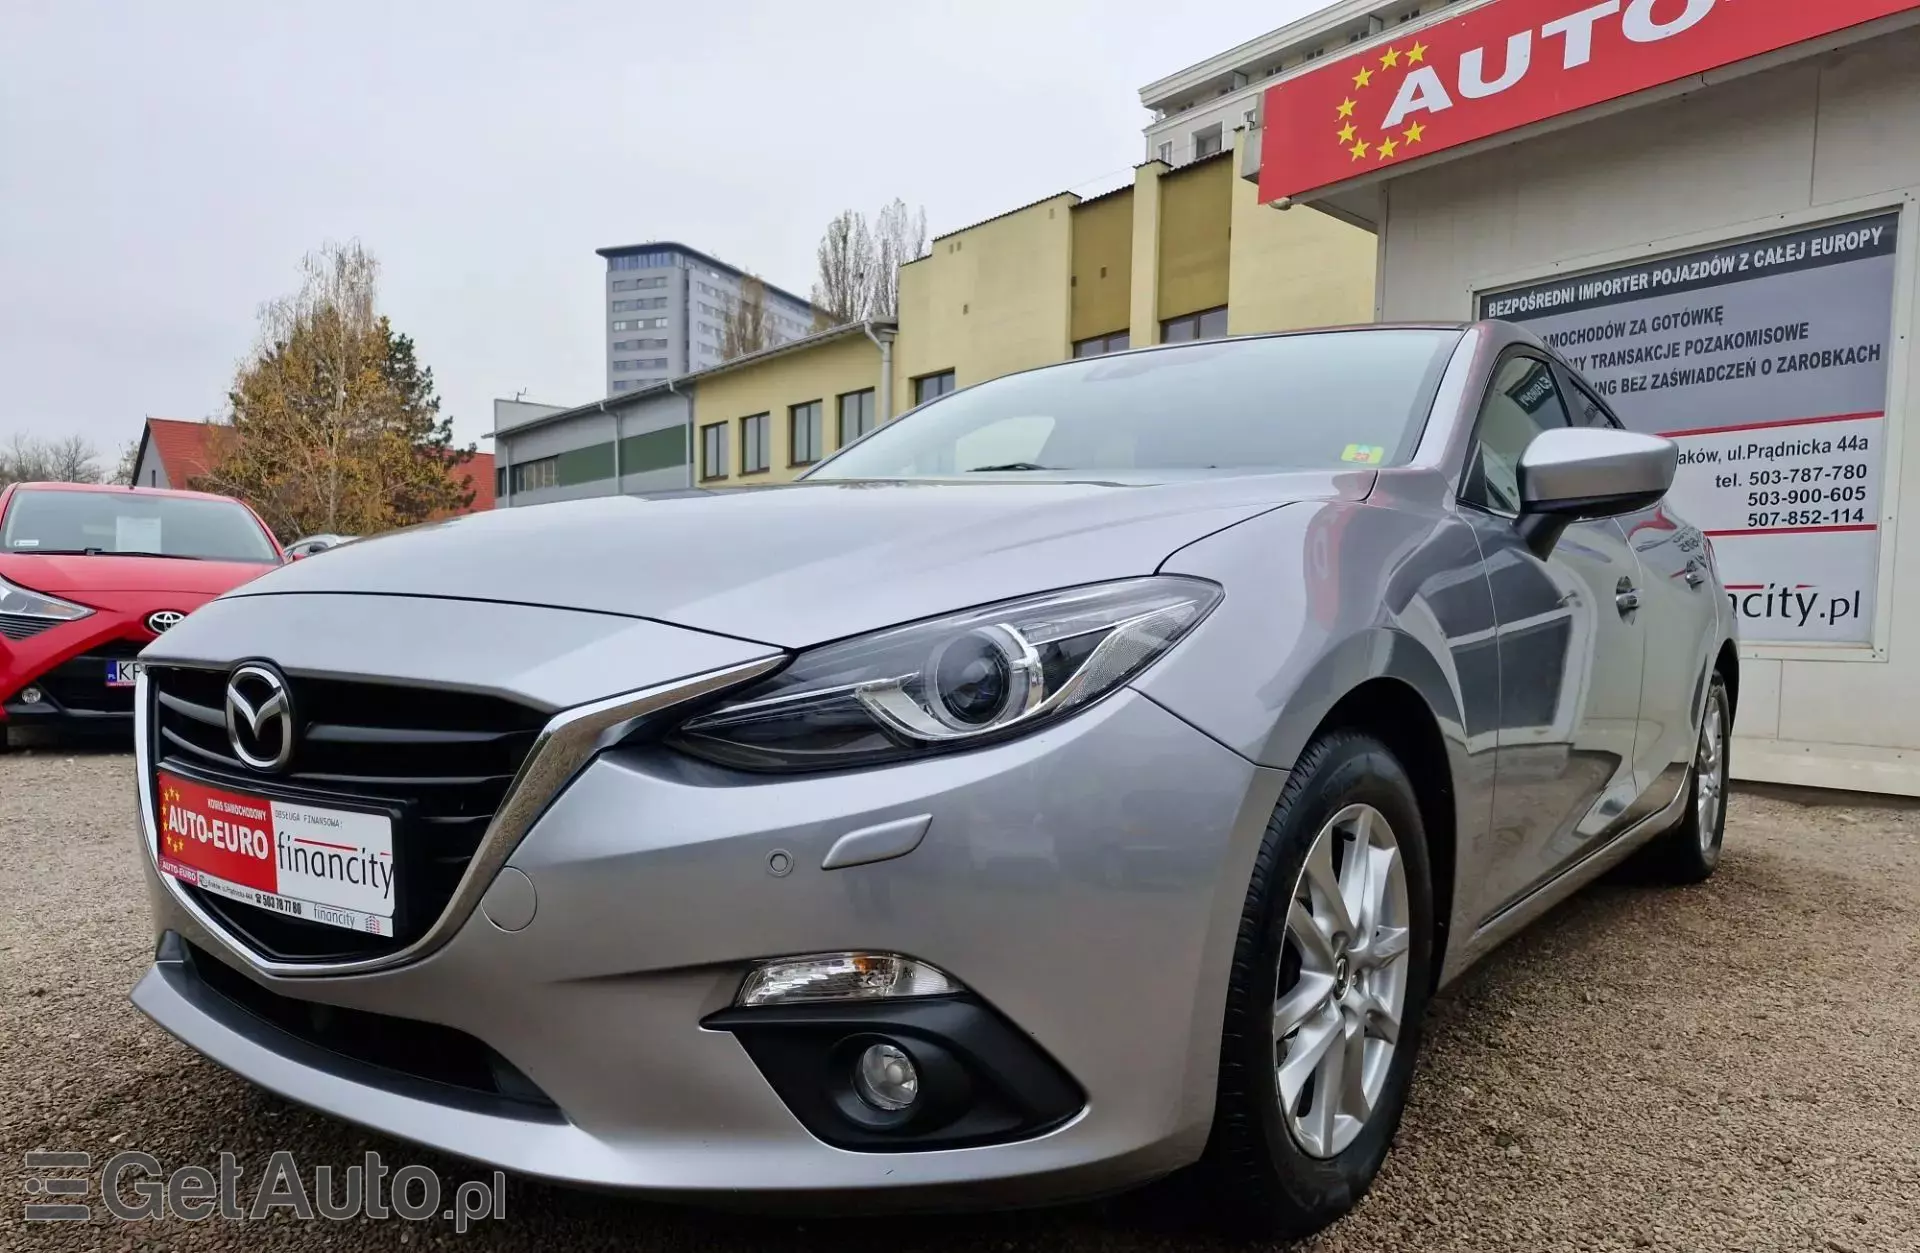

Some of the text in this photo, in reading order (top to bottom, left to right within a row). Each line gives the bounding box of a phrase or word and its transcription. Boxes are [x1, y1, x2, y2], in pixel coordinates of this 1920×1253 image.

[1488, 226, 1883, 318] BEZPOŚREDNI IMPORTER POJAZDÓW Z CAŁEJ EUROPY
[1629, 320, 1648, 337] ZA
[1651, 305, 1724, 331] GOTÓWKĘ
[1591, 345, 1680, 371] TRANSAKCJE
[1684, 322, 1809, 356] POZAKOMISOWE
[1620, 372, 1647, 393] BEZ
[1650, 357, 1757, 389] ZAŚWIADCZEŃ
[1761, 357, 1772, 375] O
[1776, 344, 1881, 372] ZAROBKACH
[1837, 435, 1868, 451] 44a
[1715, 463, 1867, 488] tel. 503-787-780
[1748, 486, 1866, 506] 503-900-605
[1748, 508, 1864, 527] 507-852-114
[169, 805, 269, 860] AUTO-EURO
[162, 860, 197, 882] AUTO-EURO
[277, 831, 394, 899] financity
[262, 894, 275, 910] 503
[314, 903, 356, 928] financity
